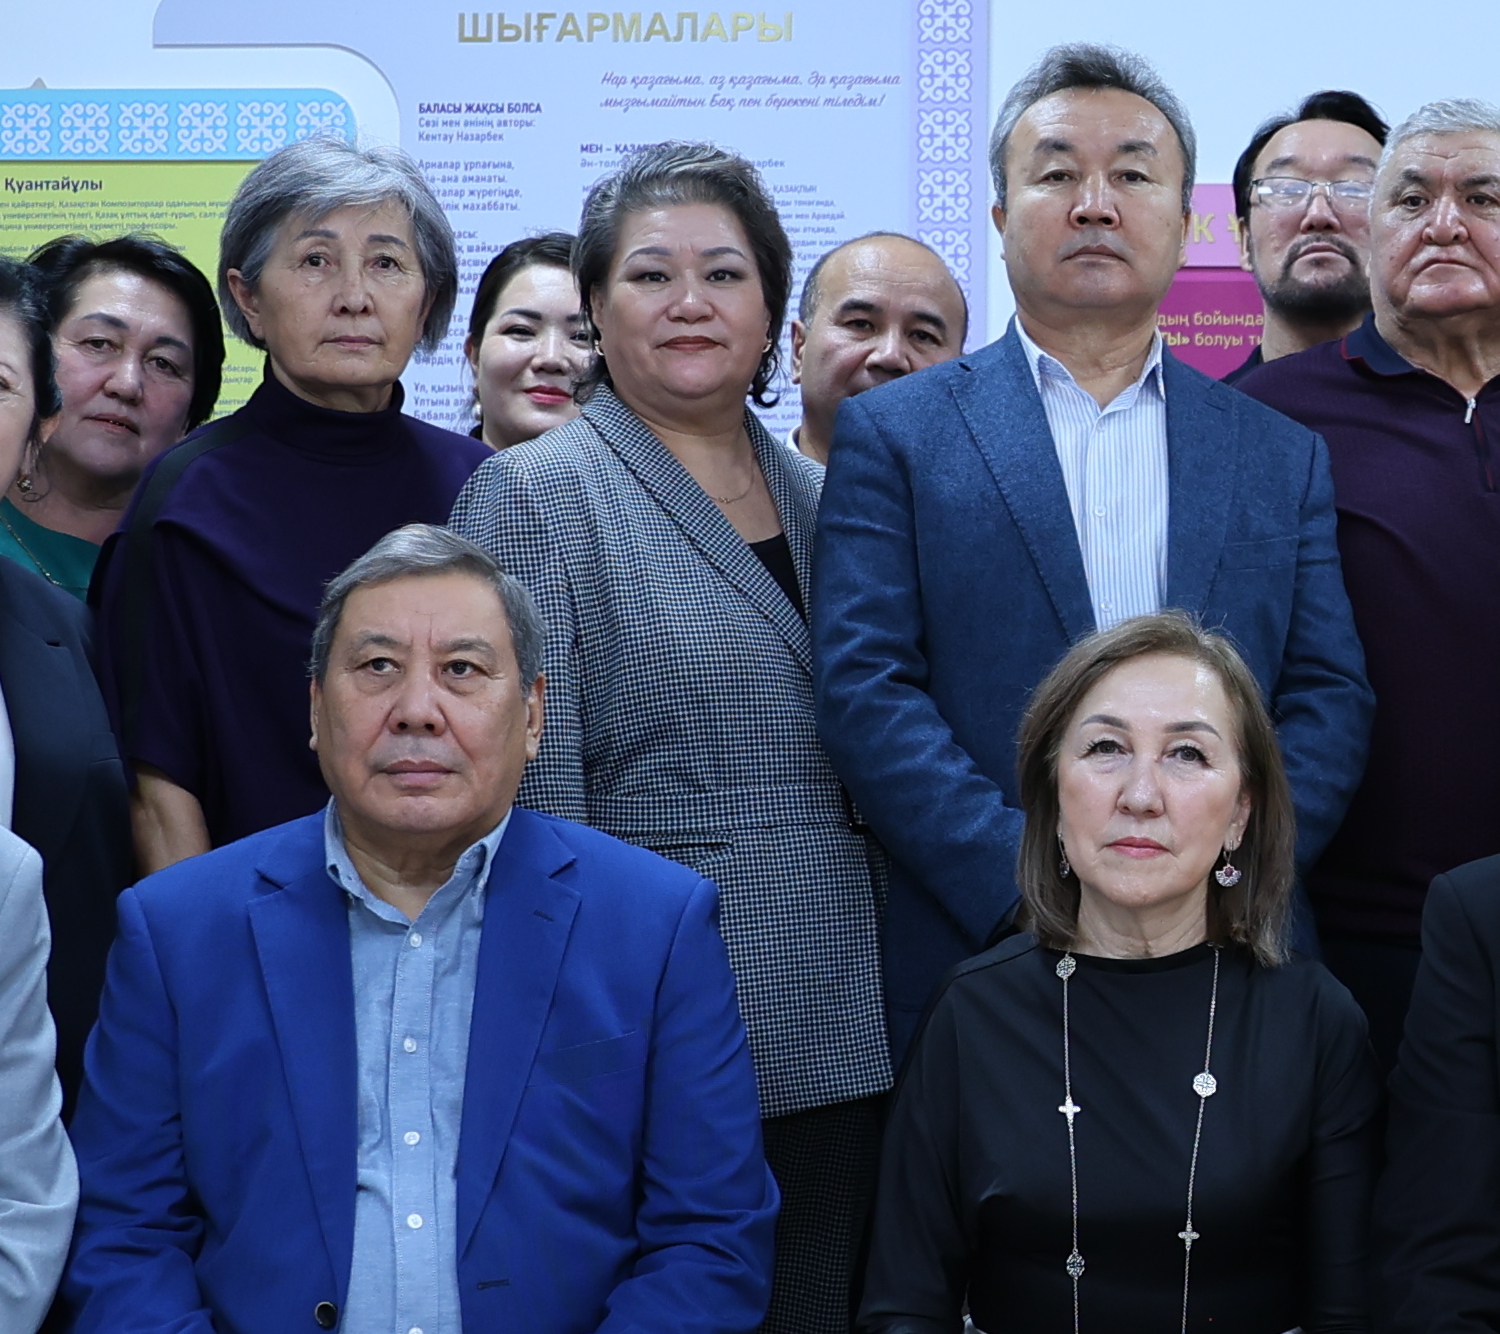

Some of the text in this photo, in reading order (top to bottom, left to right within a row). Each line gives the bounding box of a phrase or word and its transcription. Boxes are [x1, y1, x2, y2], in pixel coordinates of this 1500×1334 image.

[457, 12, 793, 43] ШЫҒАРМАЛАРЫ
[418, 102, 542, 116] БАЛАСЫ ЖАҚСЫ БОЛСА
[442, 119, 460, 128] мен
[418, 131, 504, 144] Кентау Назарбек
[580, 143, 603, 153] МЕН
[4, 175, 103, 195] Қуантайұлы
